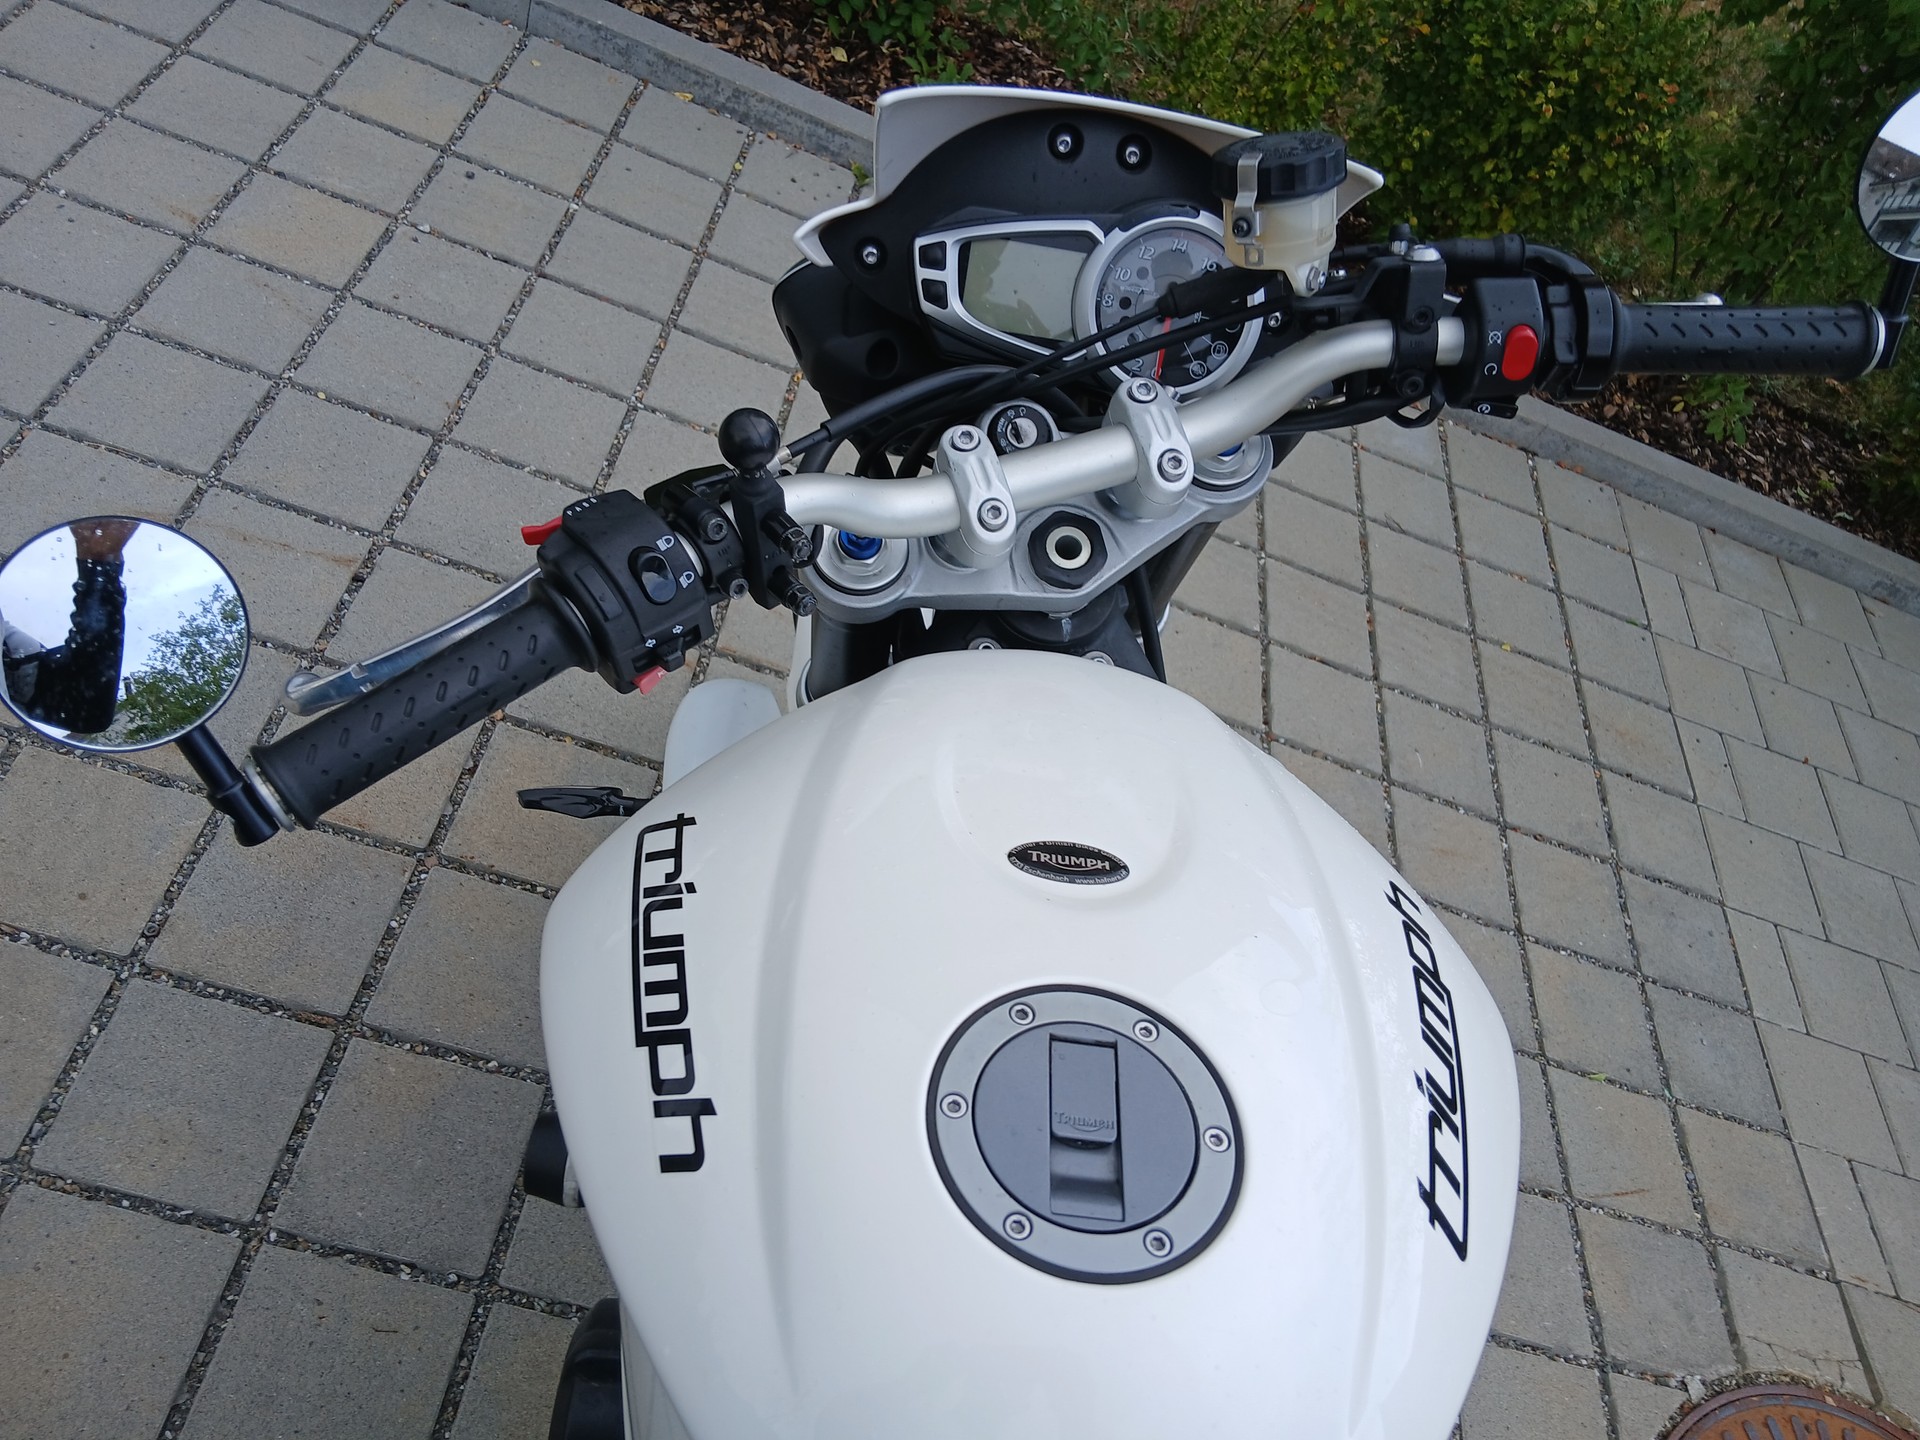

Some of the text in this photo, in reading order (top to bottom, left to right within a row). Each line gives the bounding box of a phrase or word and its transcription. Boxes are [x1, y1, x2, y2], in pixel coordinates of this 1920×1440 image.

[1138, 245, 1155, 260] 12
[1171, 239, 1188, 253] 14
[1201, 257, 1217, 272] 16
[1115, 267, 1132, 281] 10
[1102, 293, 1114, 308] 8
[1131, 358, 1144, 371] 2
[1027, 850, 1111, 871] TRIUMPH
[1023, 865, 1070, 882] Eschenbach
[1054, 1111, 1115, 1132] TRIUMPH
